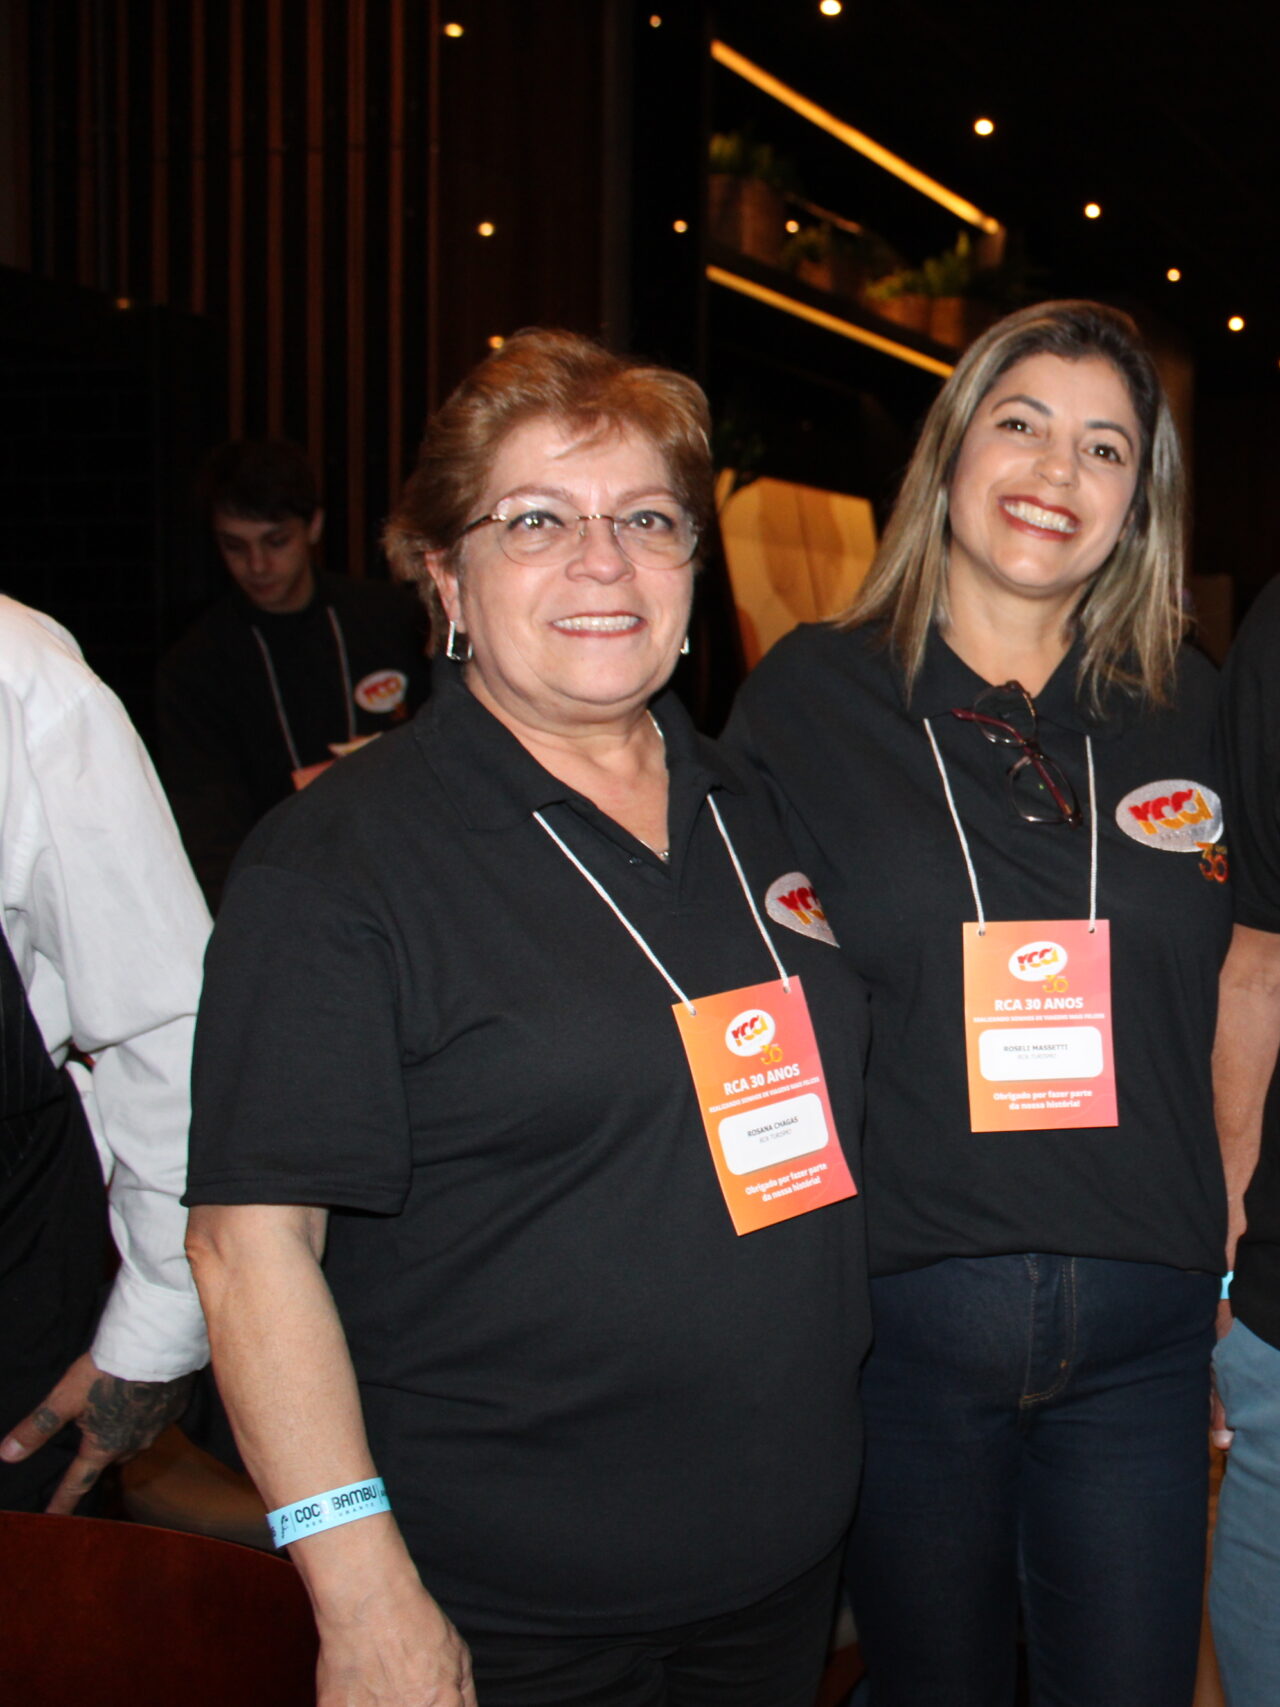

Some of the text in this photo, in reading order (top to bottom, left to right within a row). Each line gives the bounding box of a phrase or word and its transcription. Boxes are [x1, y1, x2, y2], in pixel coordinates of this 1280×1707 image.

[1128, 788, 1214, 835] rca
[994, 997, 1084, 1011] RCA 30 ANOS
[724, 1063, 801, 1096] RCA 30 ANOS
[747, 1116, 799, 1137] ROSANA CHAGAS
[294, 1501, 329, 1523] COC
[331, 1484, 378, 1511] BAMBU
